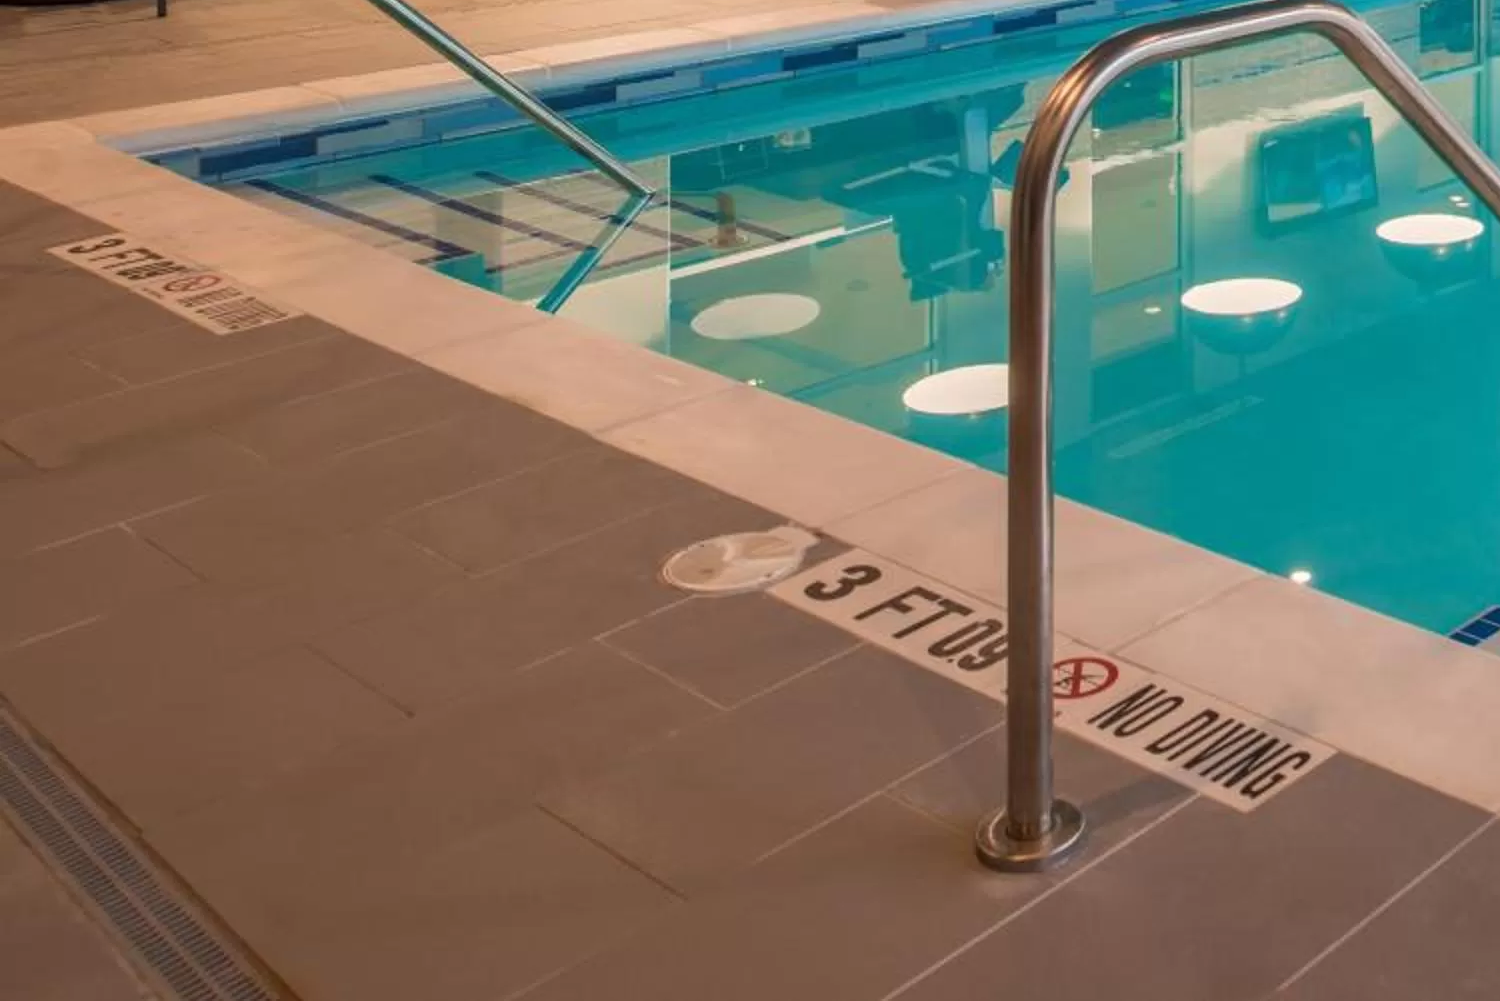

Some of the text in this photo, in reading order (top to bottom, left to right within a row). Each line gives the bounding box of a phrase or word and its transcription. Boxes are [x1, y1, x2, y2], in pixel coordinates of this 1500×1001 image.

[67, 238, 126, 254] 3
[804, 564, 882, 601] 3
[853, 586, 975, 639] FT
[1087, 683, 1185, 738] NO
[1144, 708, 1311, 800] DIVING
